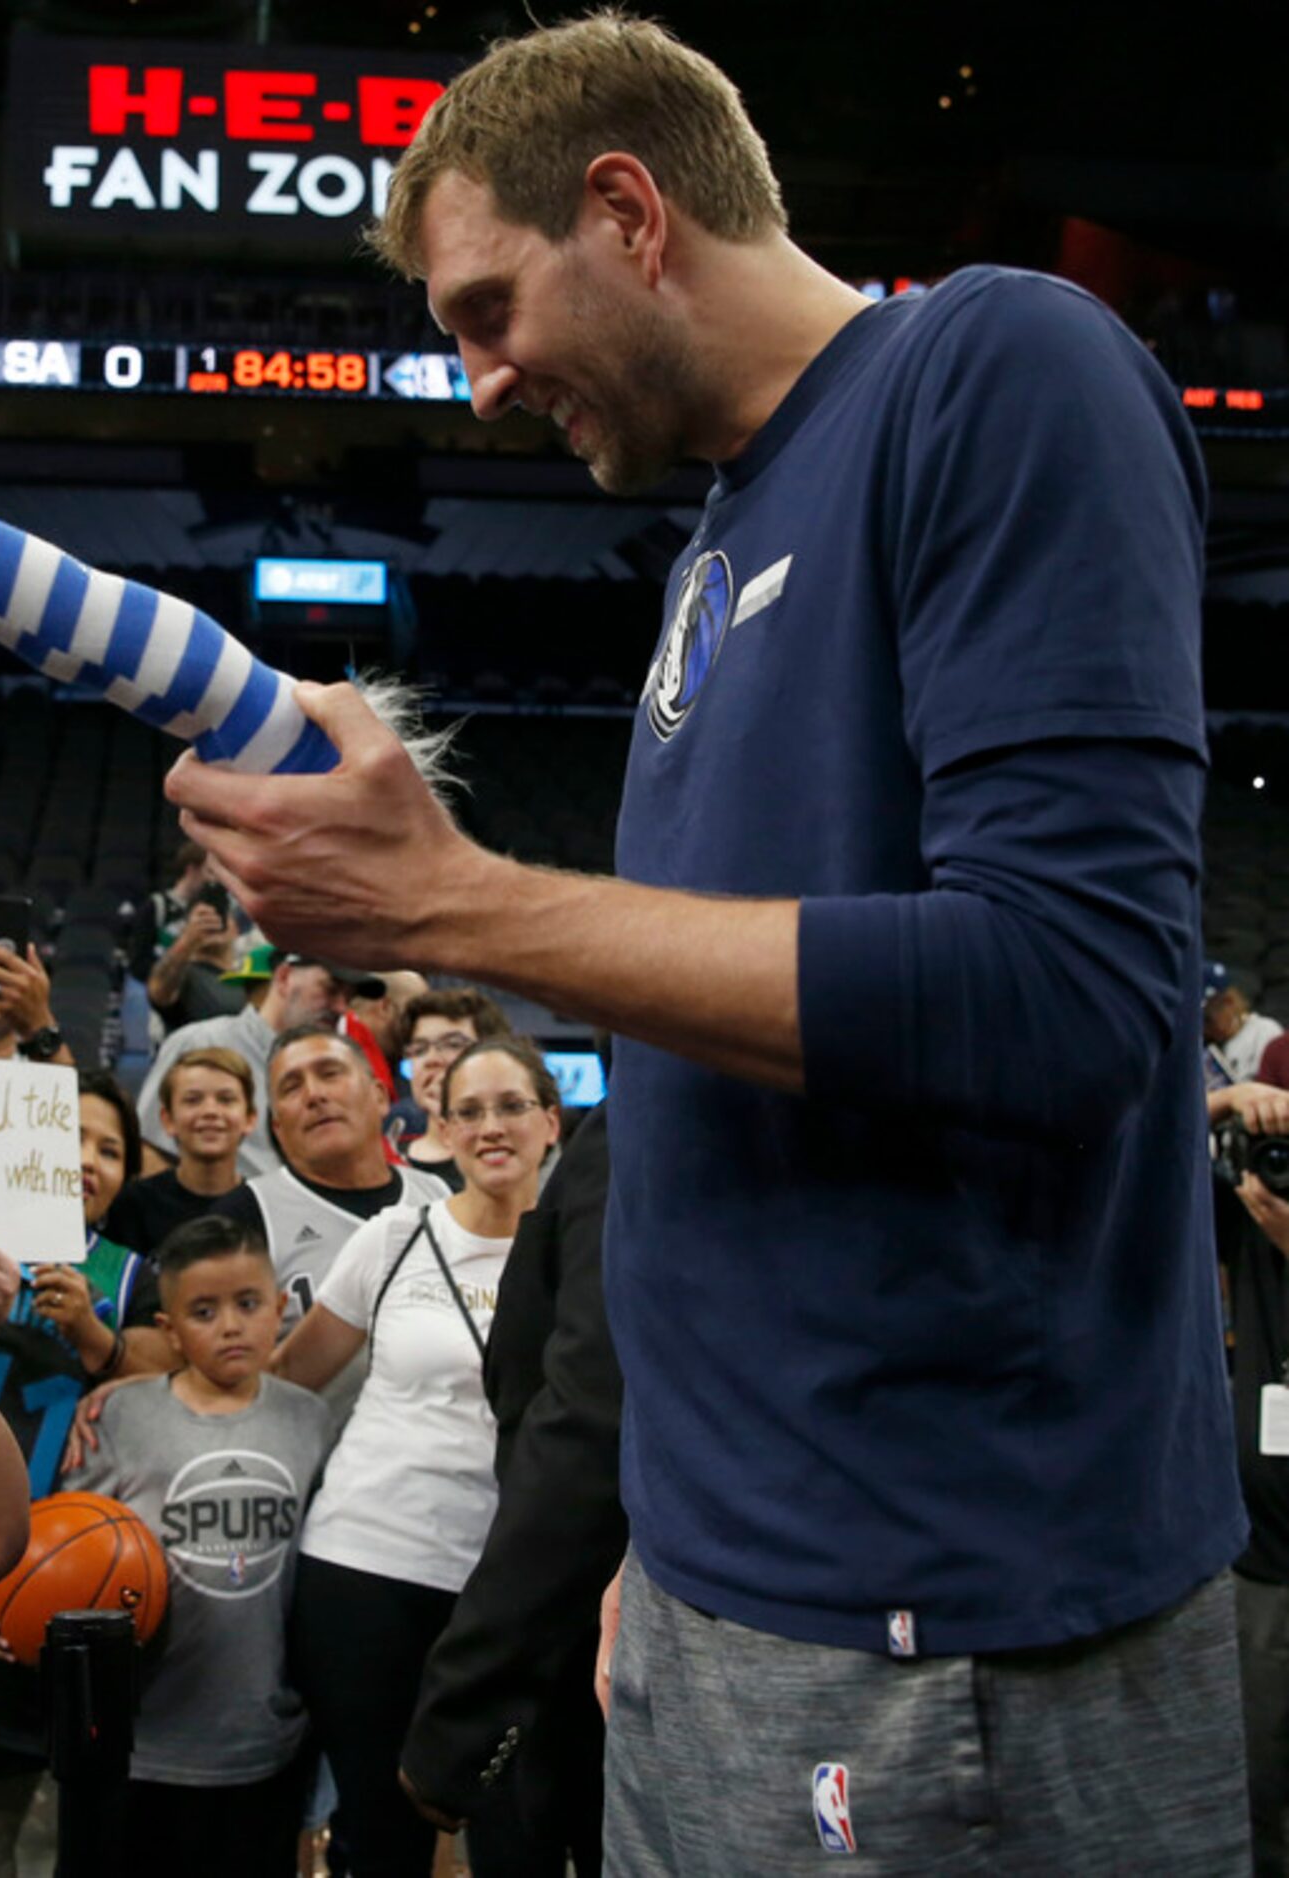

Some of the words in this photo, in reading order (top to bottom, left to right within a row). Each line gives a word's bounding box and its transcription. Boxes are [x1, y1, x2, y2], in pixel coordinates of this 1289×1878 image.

[88, 65, 447, 147] H-E-B
[44, 145, 219, 211] FAN
[1, 341, 75, 386] SA
[200, 347, 216, 372] 1
[234, 350, 366, 391] 84:58
[22, 1082, 72, 1132] take
[5, 1148, 48, 1194] with
[52, 1166, 84, 1199] me
[160, 1496, 299, 1547] SPURS
